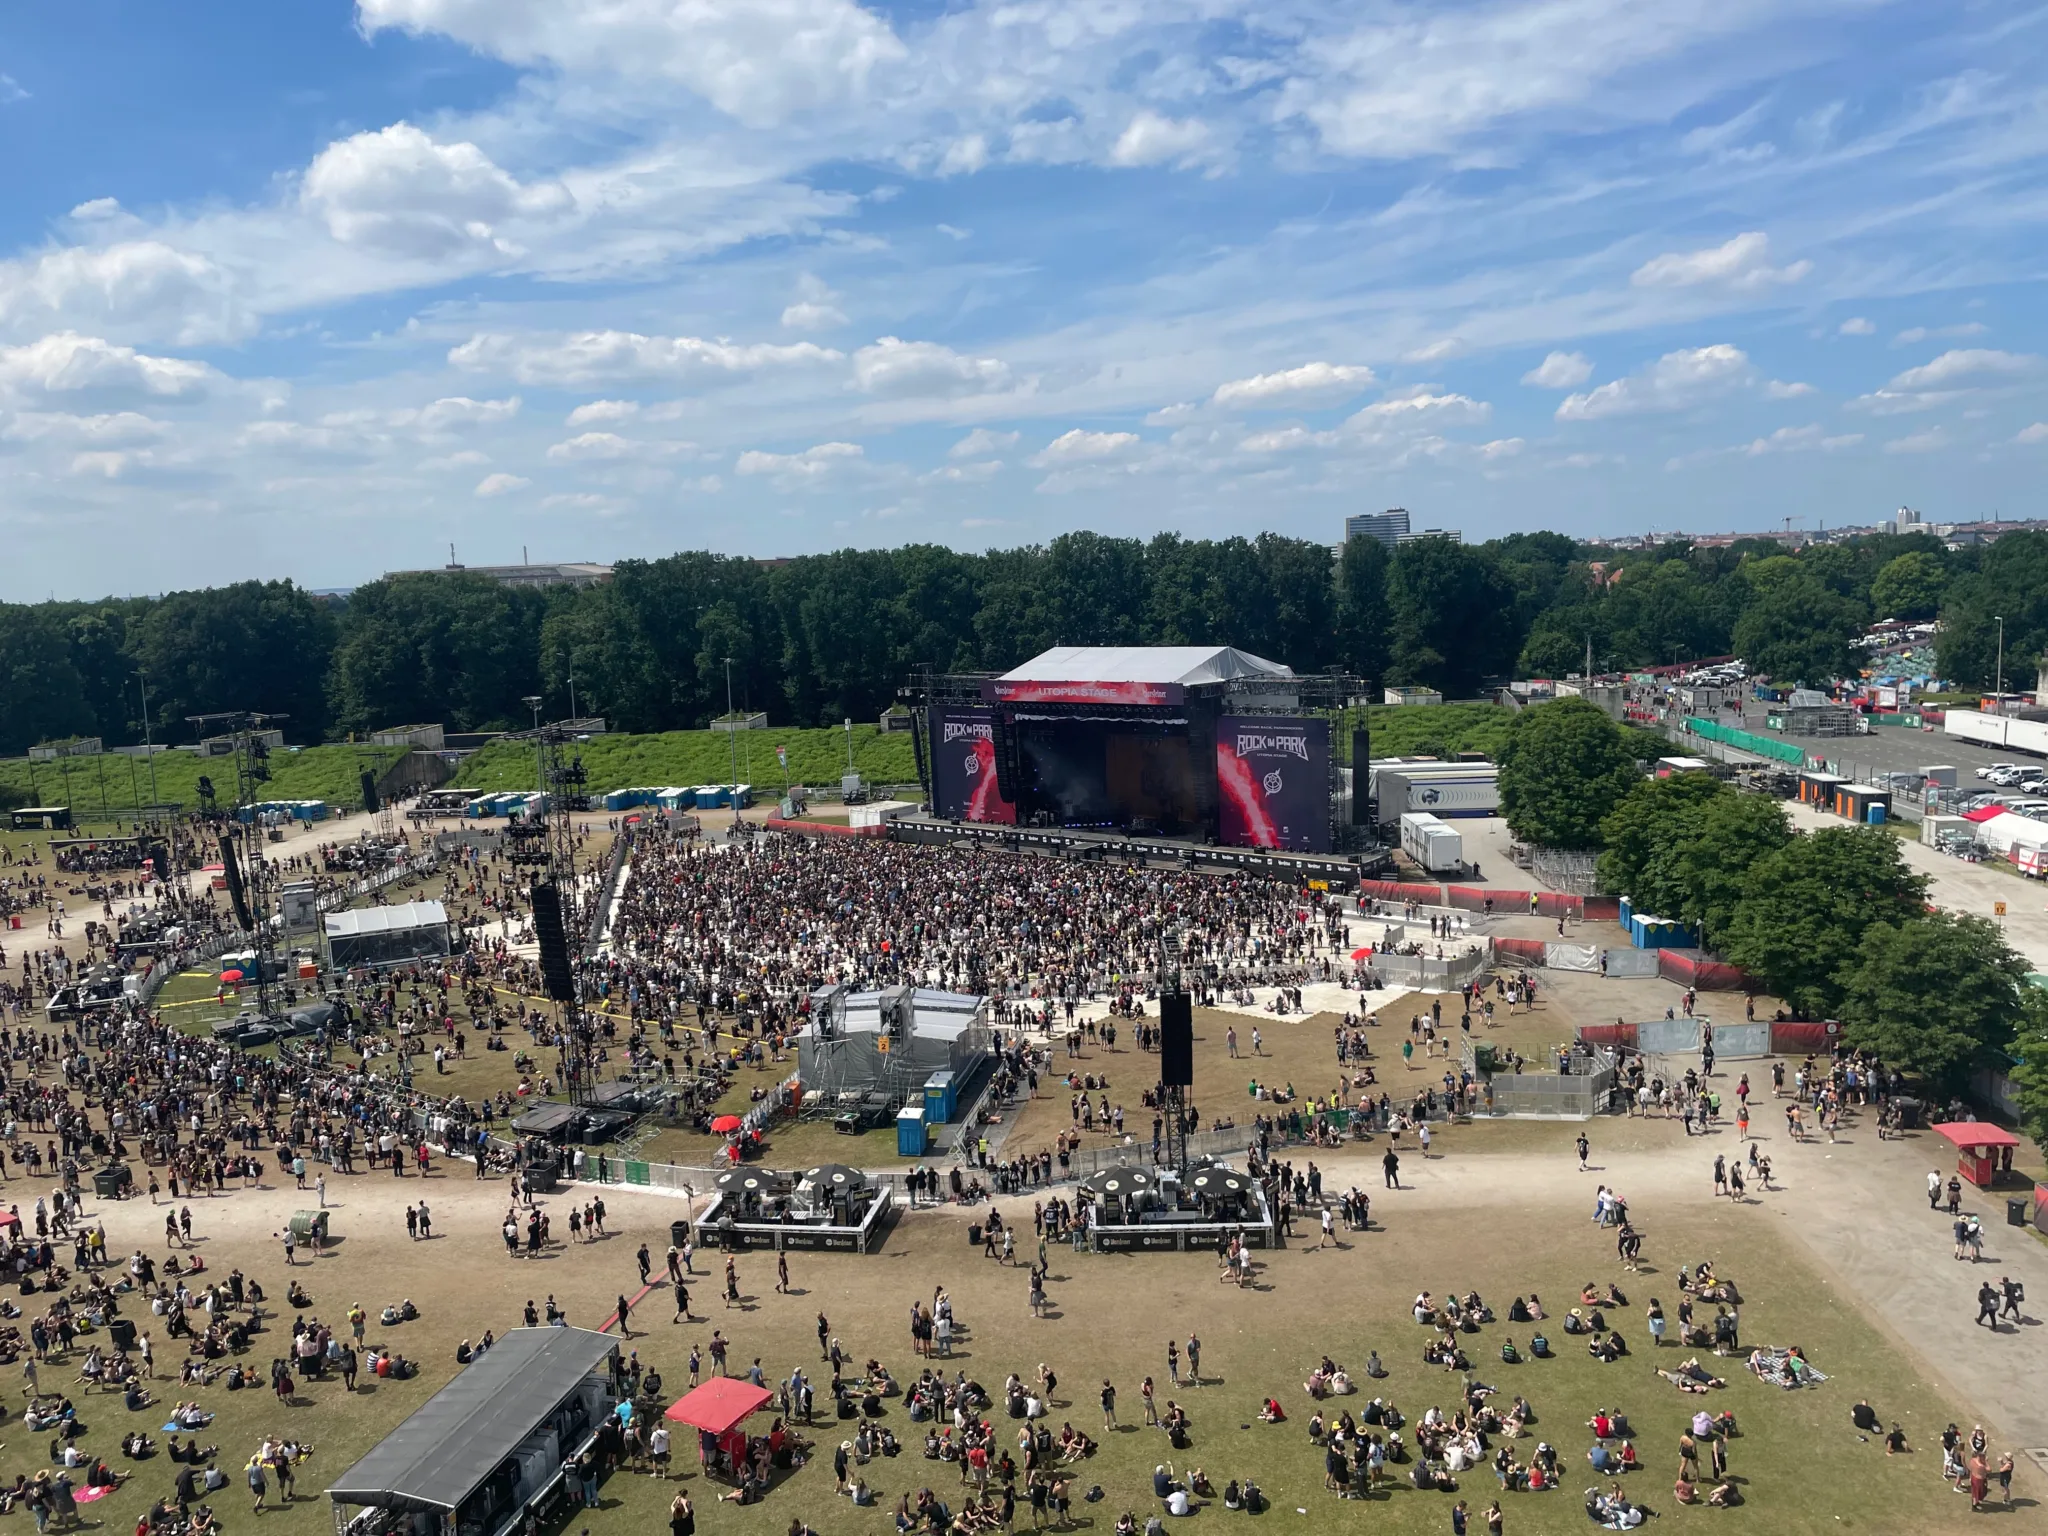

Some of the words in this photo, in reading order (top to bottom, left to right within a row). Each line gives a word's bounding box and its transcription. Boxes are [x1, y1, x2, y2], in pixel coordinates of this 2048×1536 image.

[1038, 687, 1078, 697] UTOPIA
[1080, 688, 1117, 697] STAGE
[944, 722, 967, 743] ROCK
[1236, 734, 1267, 758] ROCK
[1267, 737, 1275, 747] IM
[1275, 735, 1309, 761] PARK
